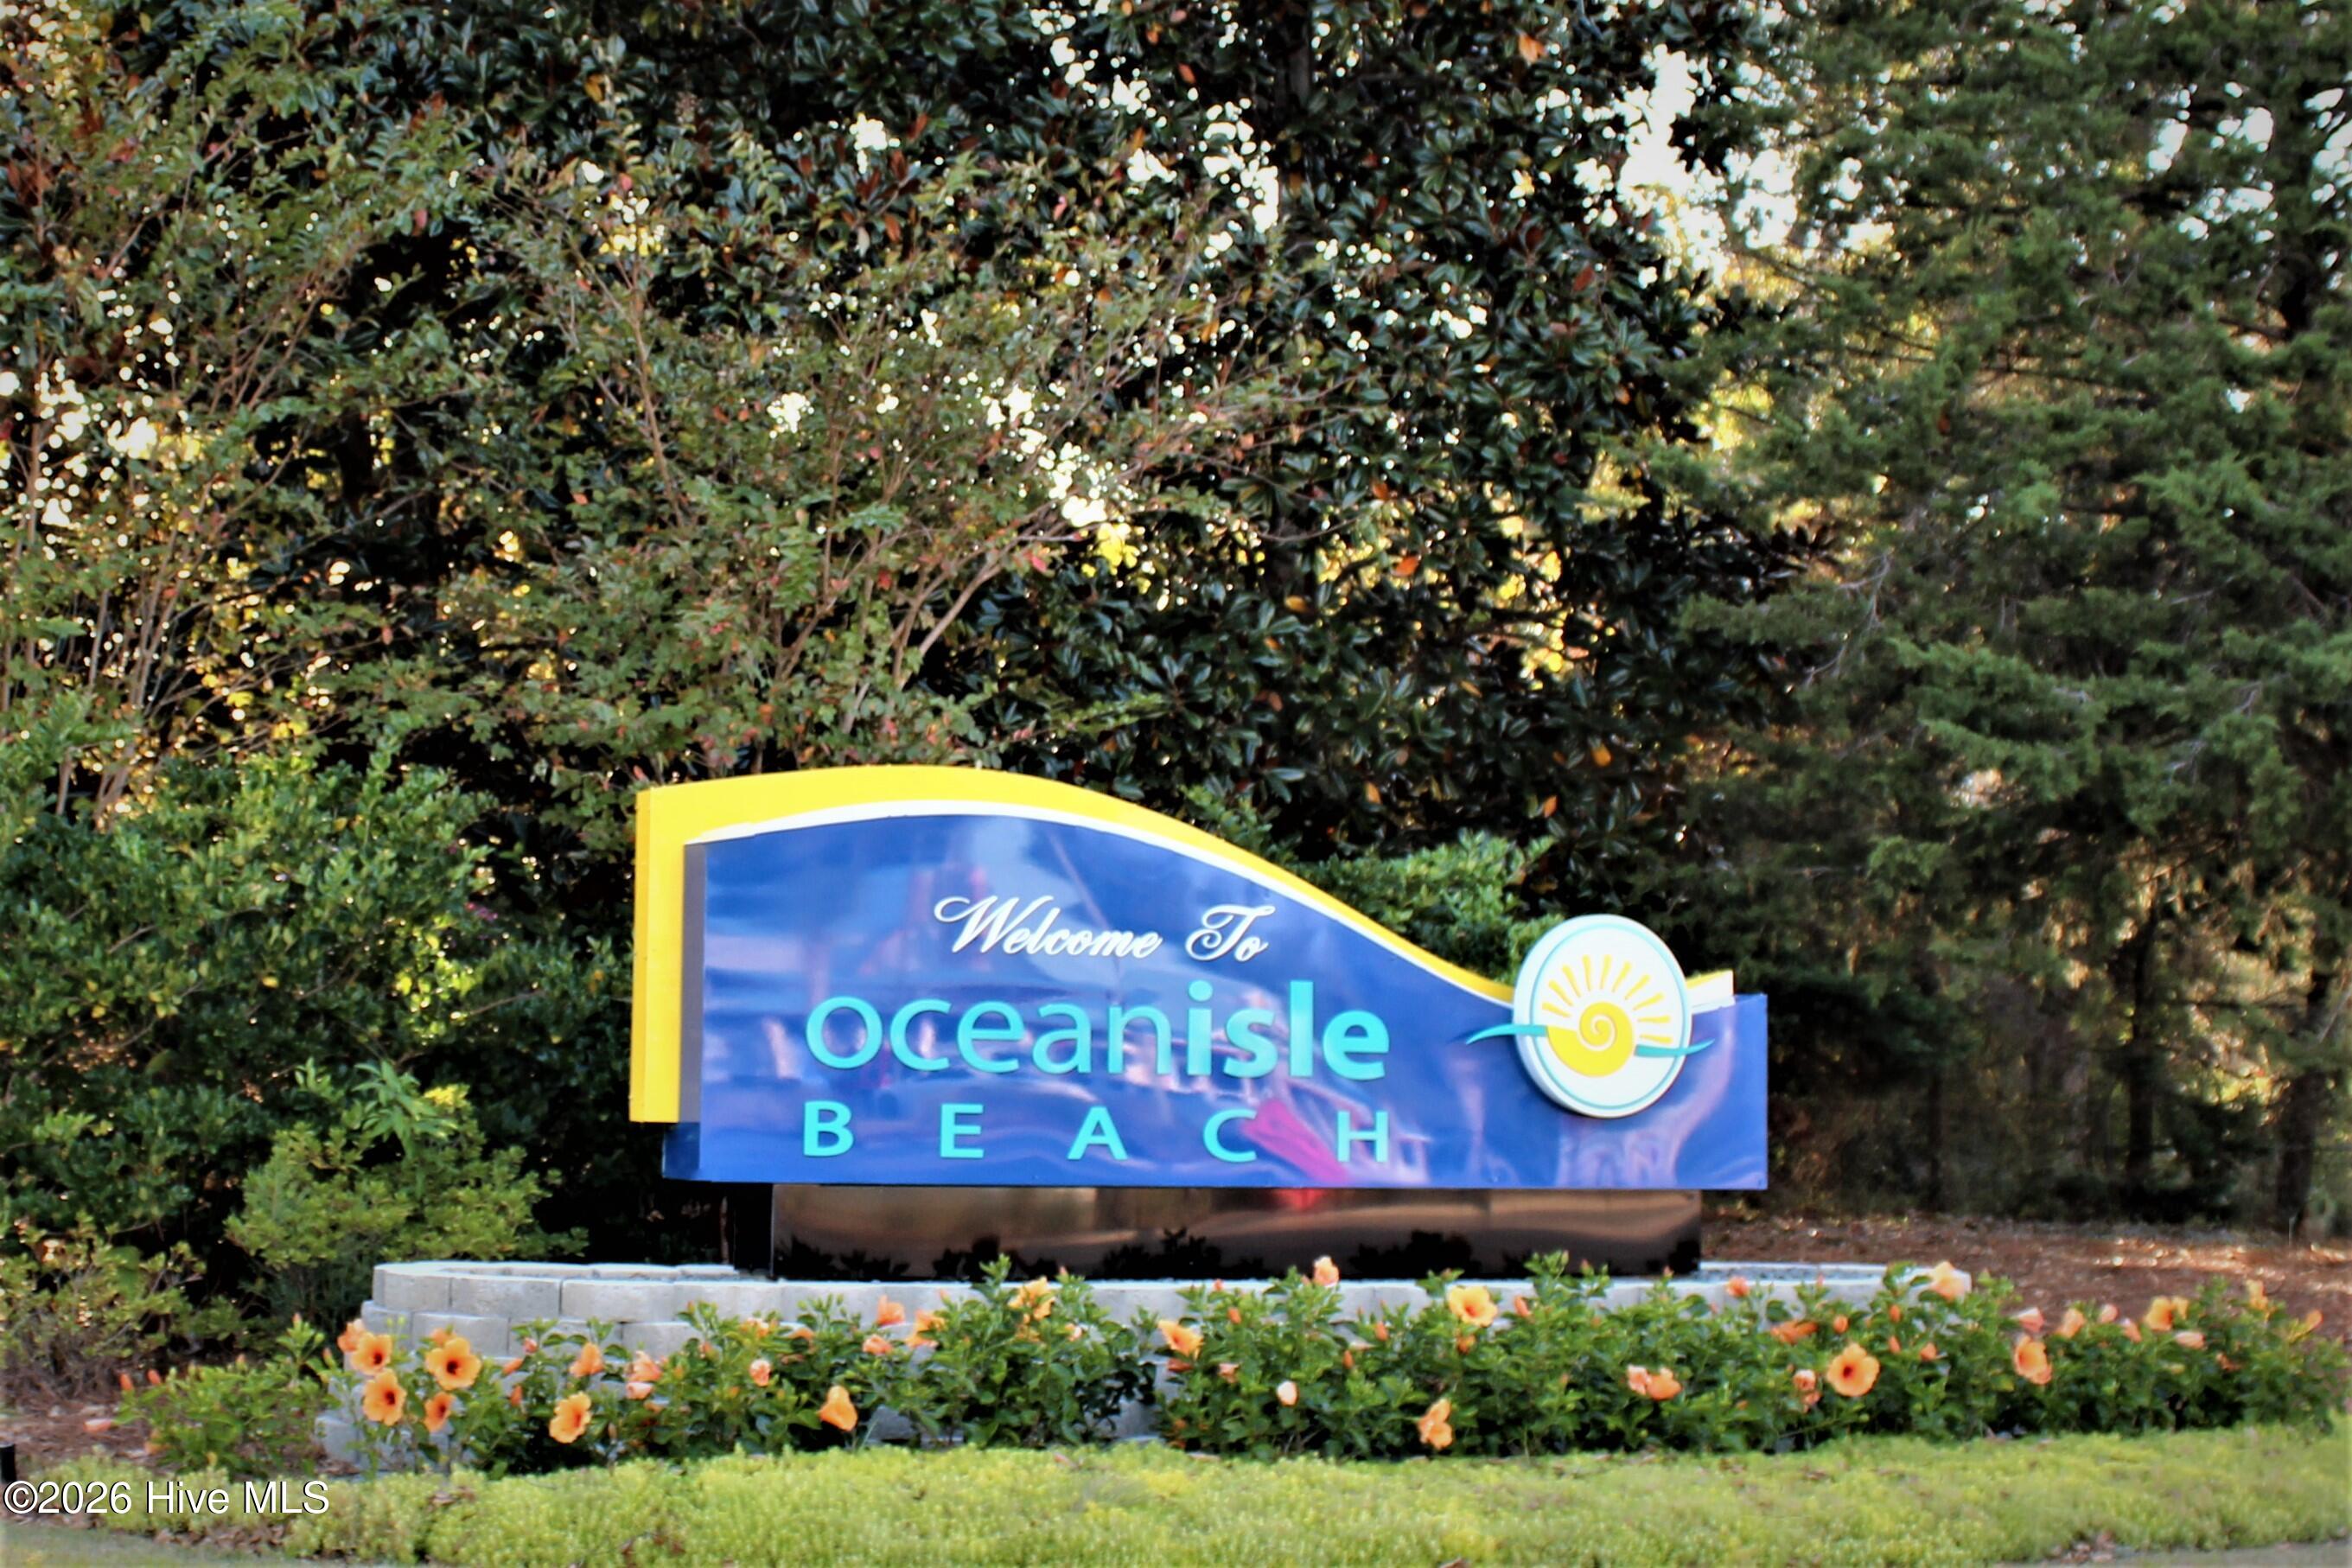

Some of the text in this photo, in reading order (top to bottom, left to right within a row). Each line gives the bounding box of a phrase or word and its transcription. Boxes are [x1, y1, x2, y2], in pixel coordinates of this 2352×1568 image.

[934, 896, 1276, 962] Welcome To
[802, 1100, 1389, 1163] BEACH
